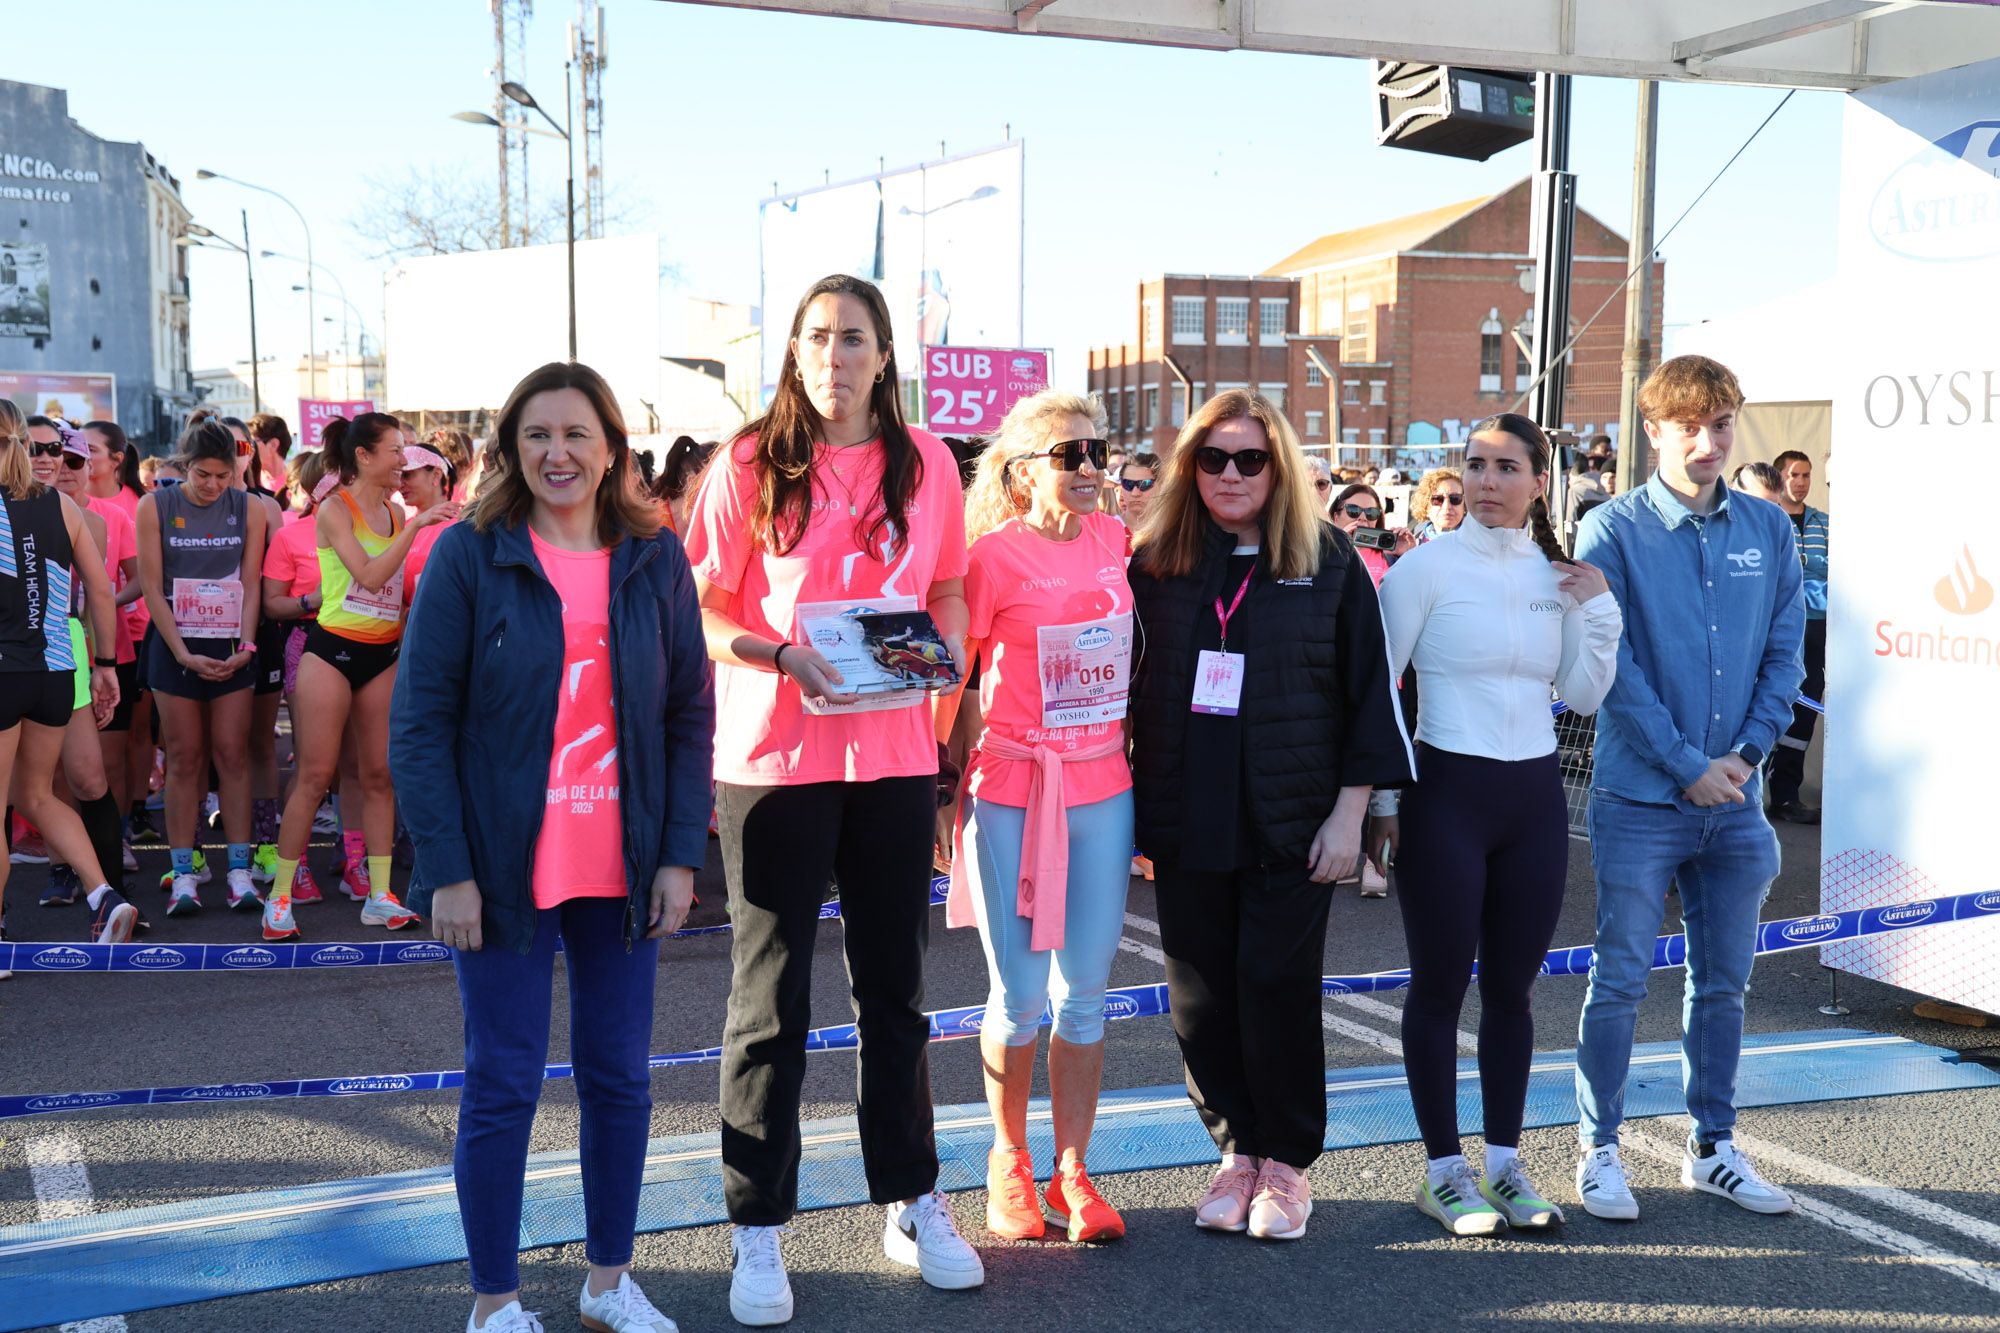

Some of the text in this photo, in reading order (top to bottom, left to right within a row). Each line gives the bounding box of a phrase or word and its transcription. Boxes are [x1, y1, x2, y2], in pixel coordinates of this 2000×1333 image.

[0, 187, 71, 203] matico
[931, 352, 992, 379] SUB
[308, 403, 344, 419] SUB
[930, 389, 997, 426] 25'
[310, 422, 322, 443] 3
[169, 533, 242, 547] Esenciarun
[22, 533, 41, 630] TEAM HICHAM
[1022, 577, 1067, 592] OYSHO
[381, 586, 393, 597] 16
[197, 605, 224, 616] 016
[1077, 634, 1111, 647] ASTURIANA
[1874, 620, 2000, 667] Santan
[1079, 664, 1115, 685] 016
[1088, 686, 1105, 696] 1990
[1055, 710, 1090, 721] OYSHO
[571, 785, 587, 800] DE
[590, 785, 605, 800] LA
[571, 802, 594, 814] 2025
[1883, 906, 1932, 921] ASTURIANA
[1786, 922, 1836, 937] ASTURIANA
[37, 956, 87, 965] ASTURIANA
[134, 955, 181, 964] ASTURIANA
[226, 955, 272, 963] ASTURIANA
[316, 953, 359, 961] ASTURIANA
[402, 951, 444, 959] ASTURIANA
[337, 1081, 406, 1091] ASTURIANA
[191, 1089, 264, 1098] ASTURIANA
[34, 1094, 113, 1108] ASTURIANA
